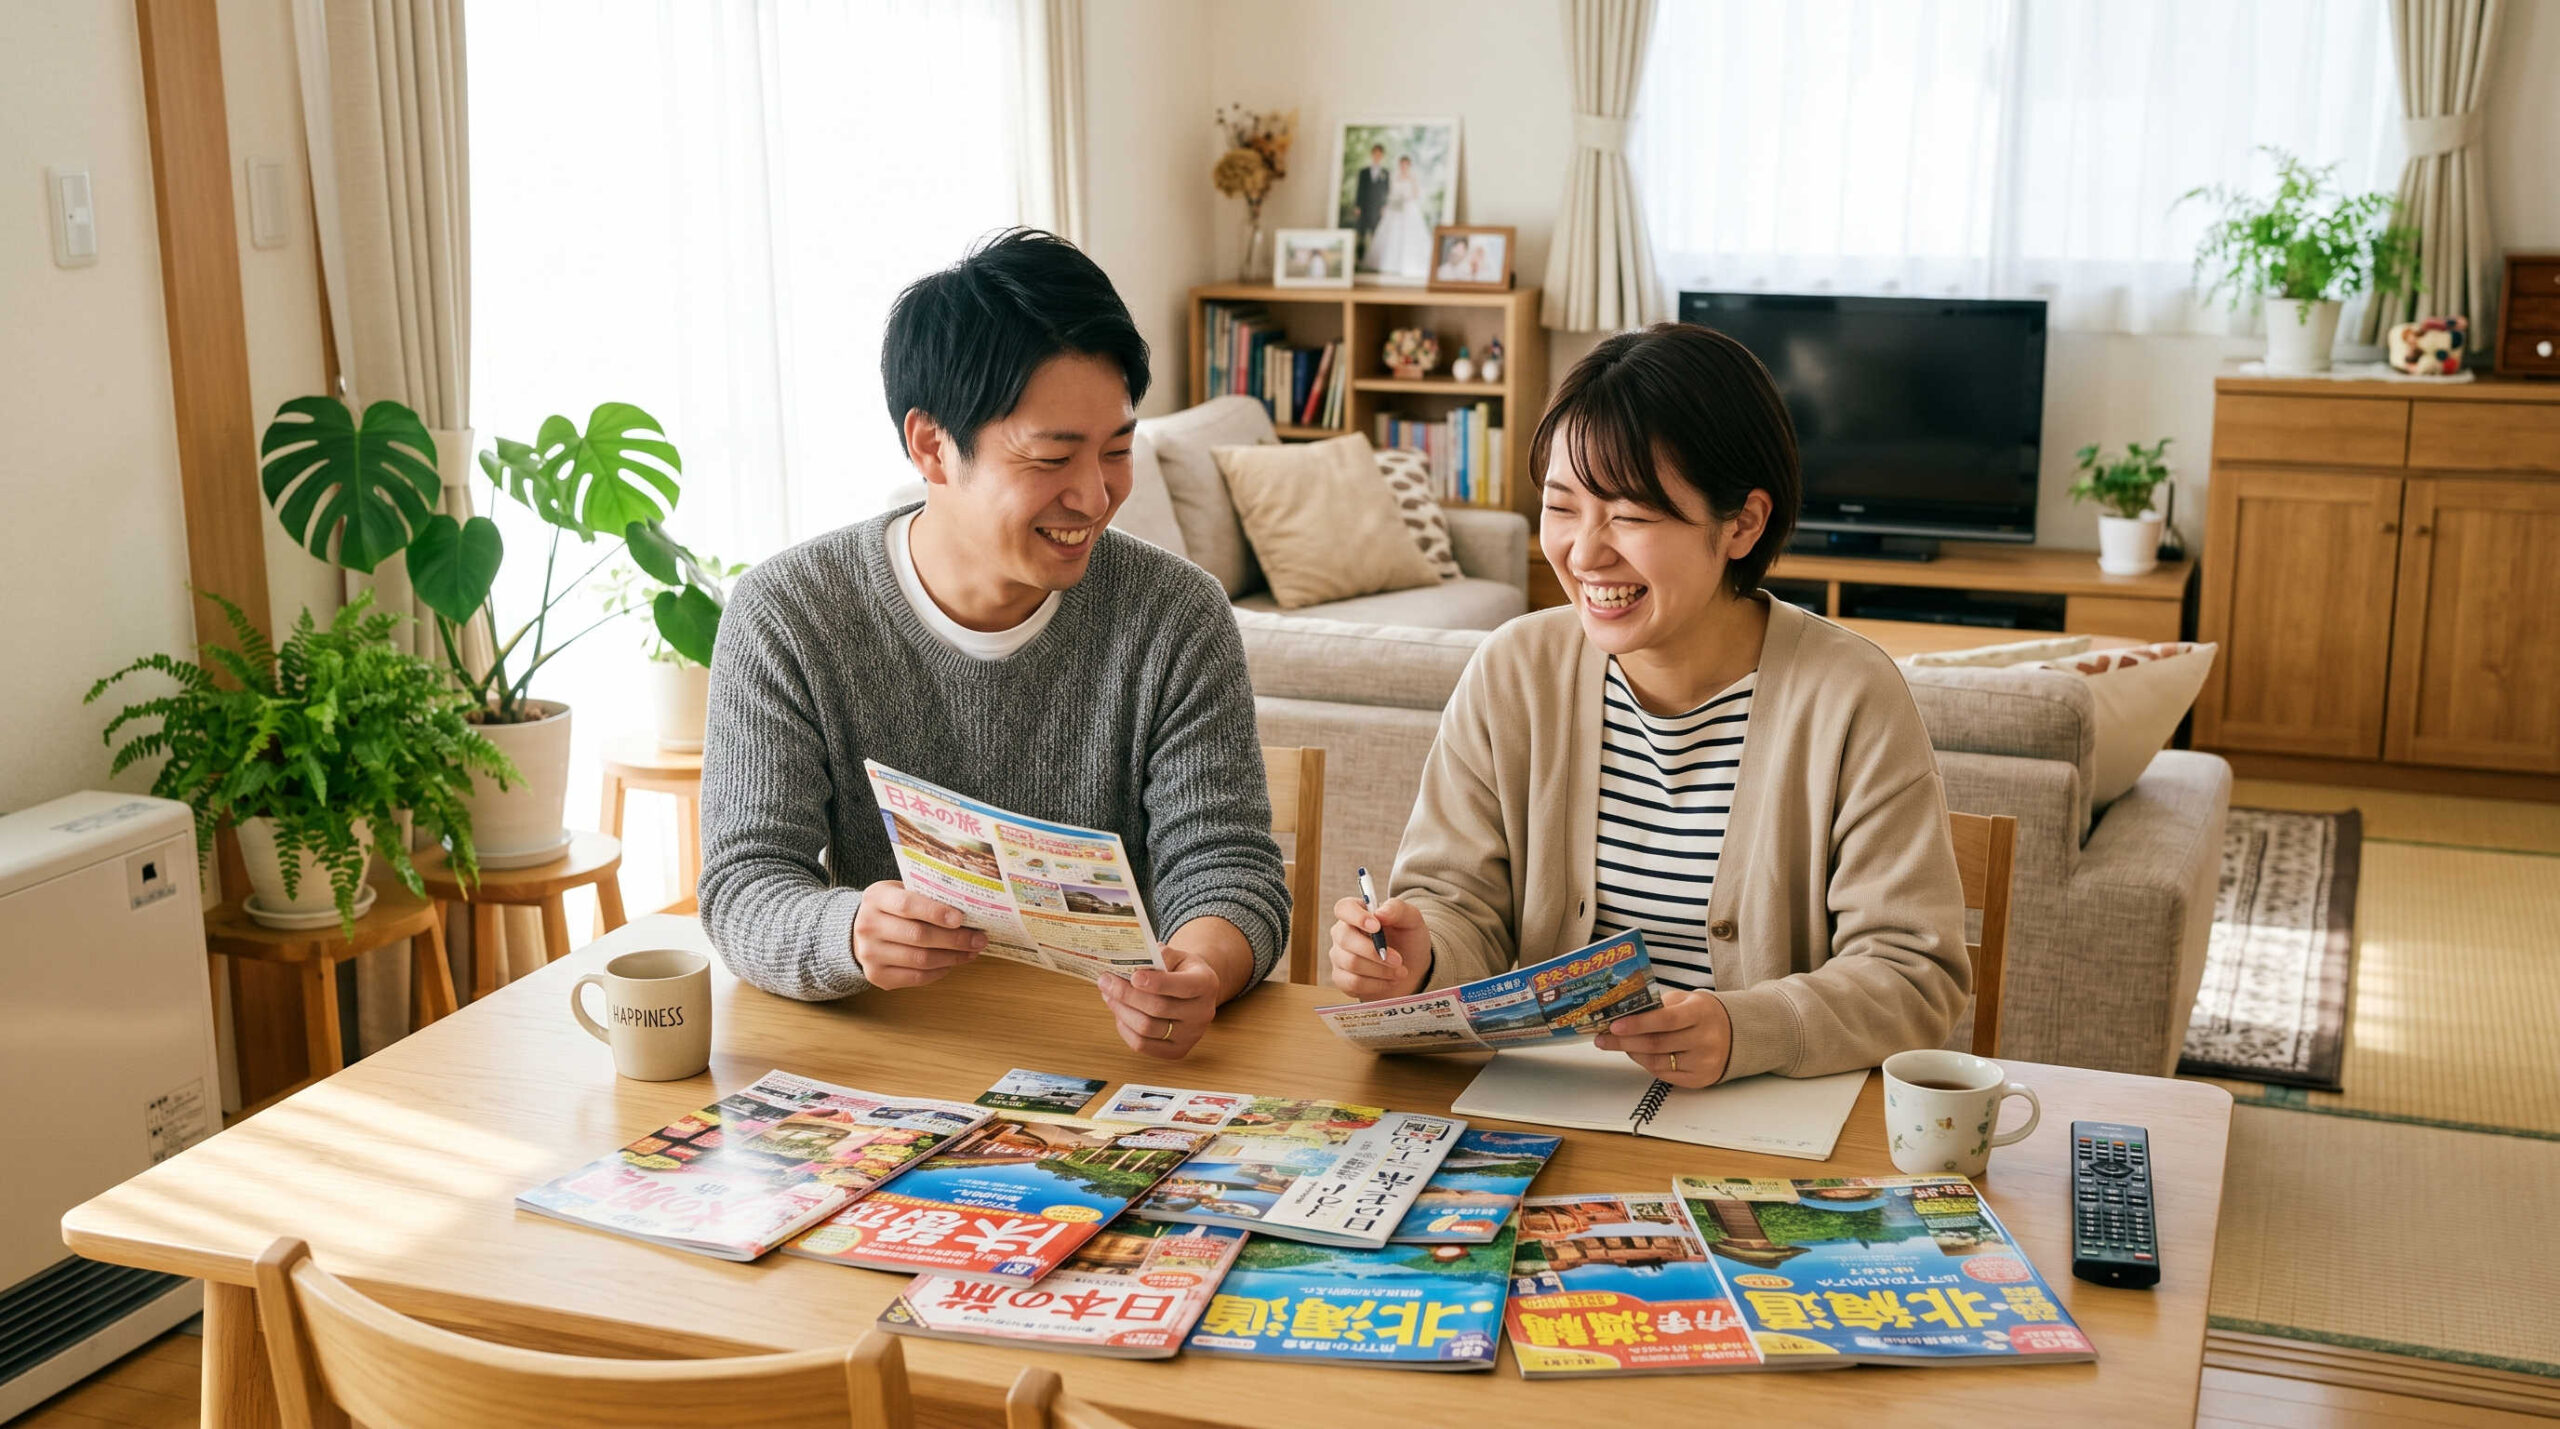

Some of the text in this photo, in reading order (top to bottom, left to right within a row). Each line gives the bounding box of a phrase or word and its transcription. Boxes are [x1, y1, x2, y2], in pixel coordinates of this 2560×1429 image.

[885, 784, 985, 838] 日本の旅
[613, 1004, 684, 1028] HAPPINESS
